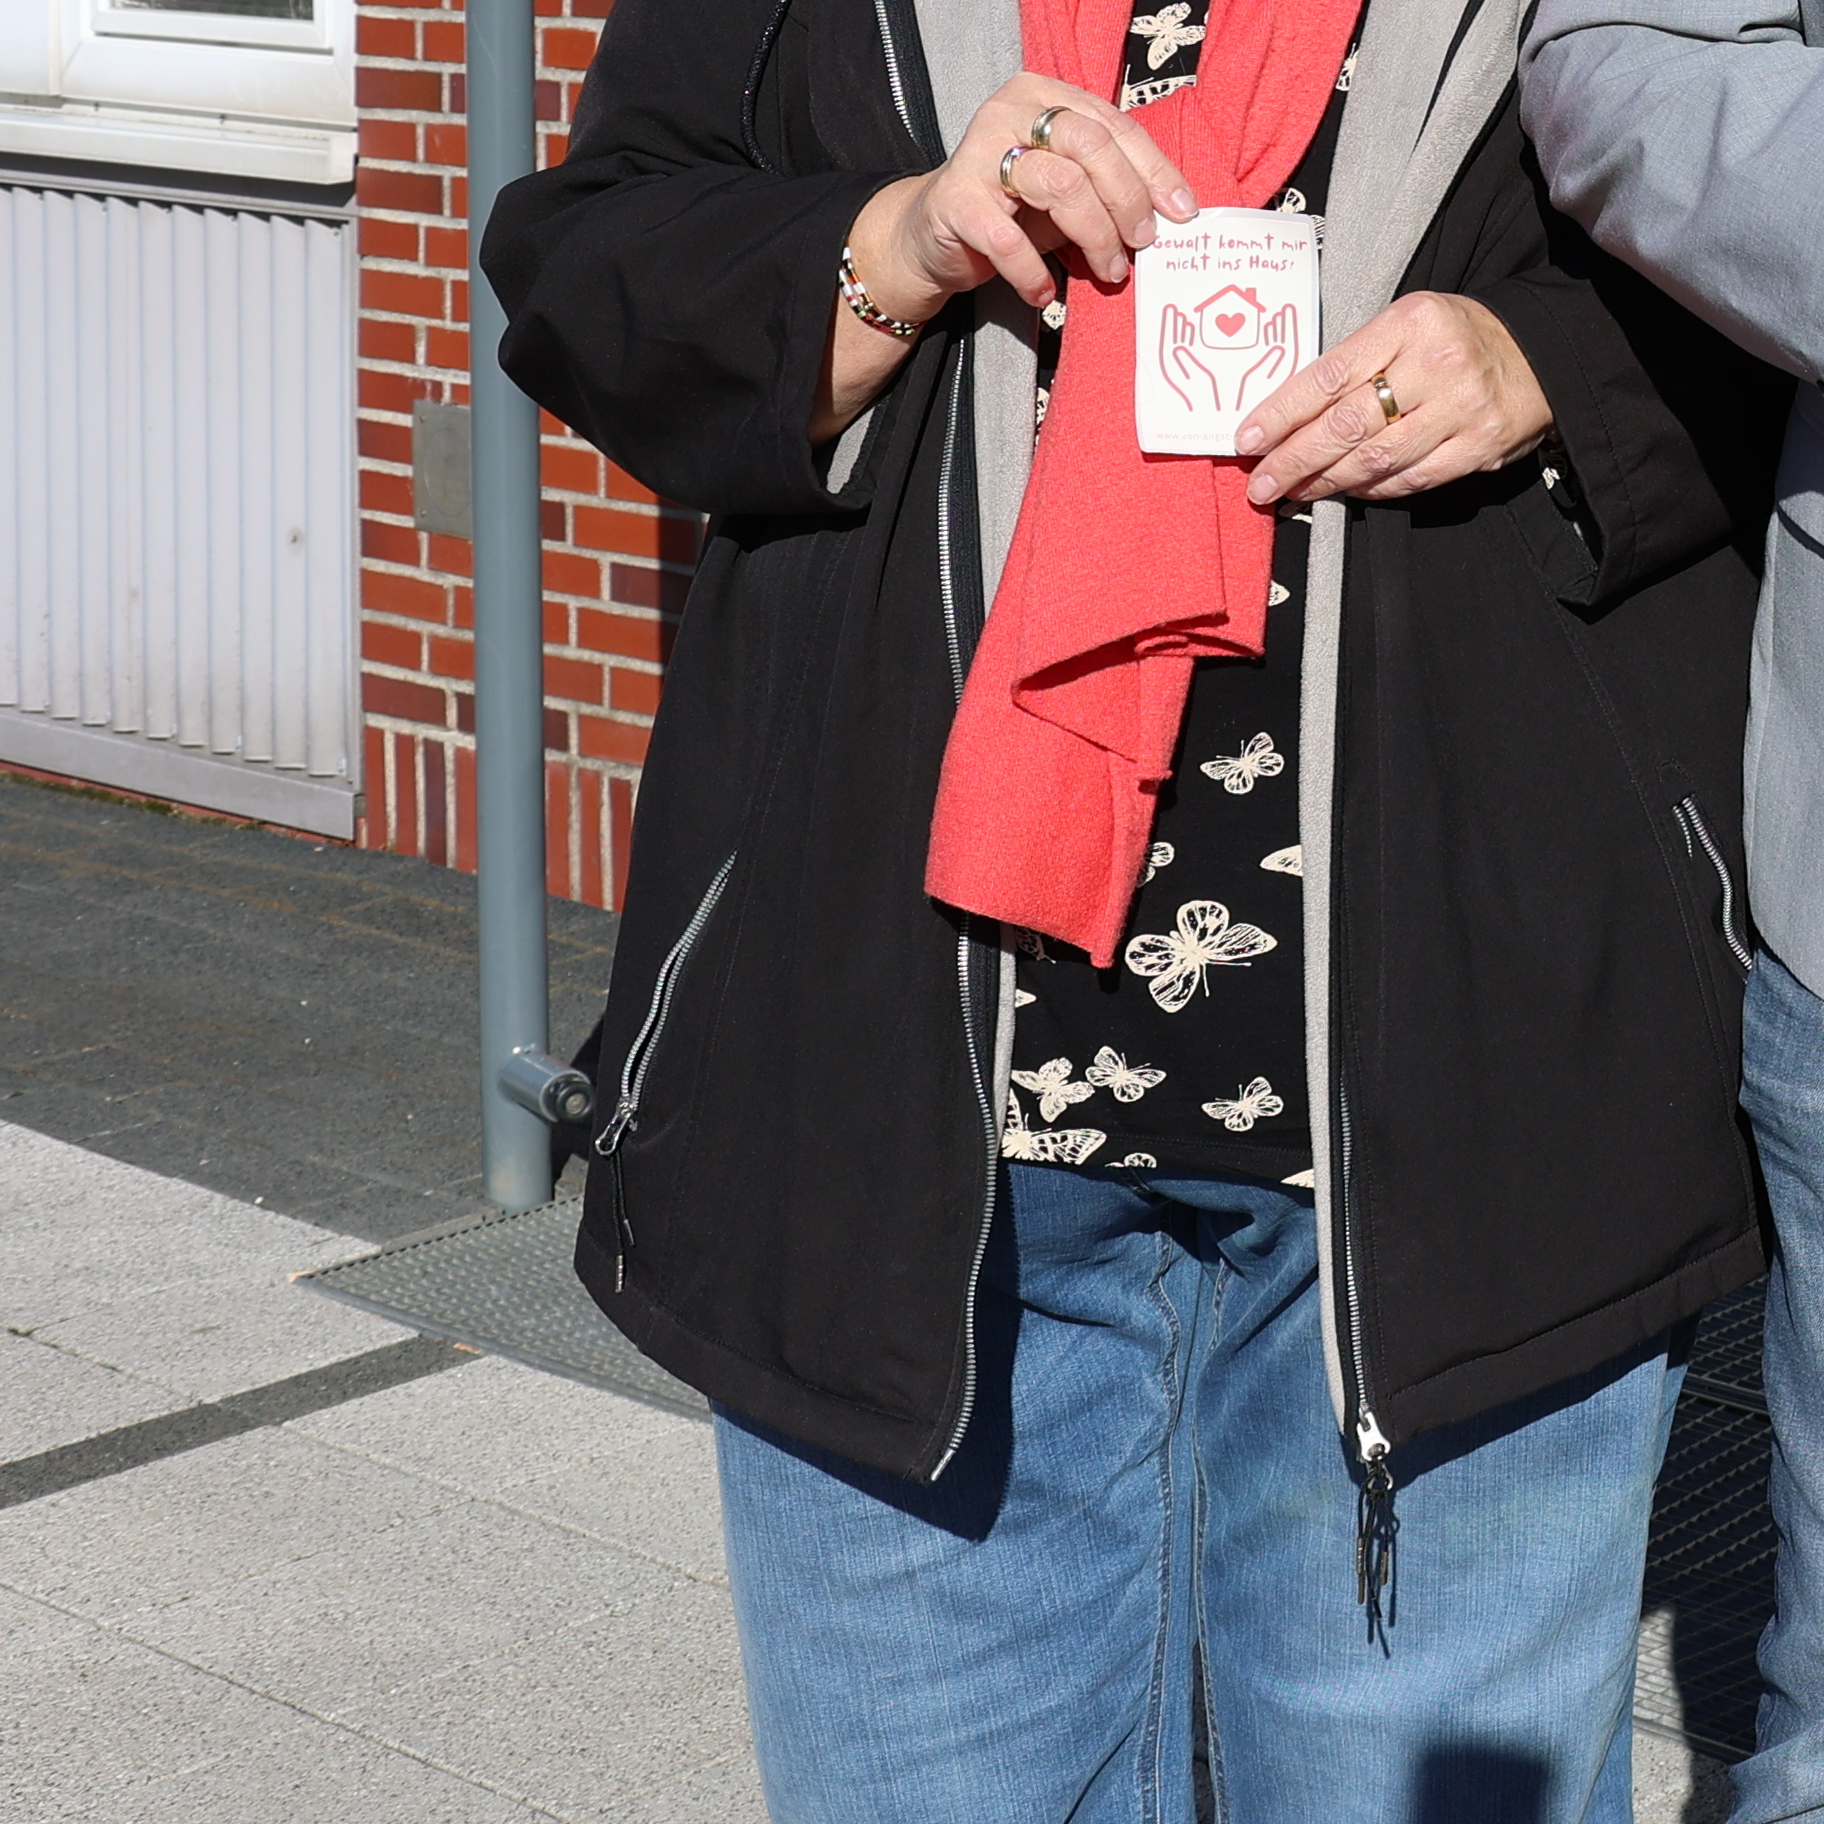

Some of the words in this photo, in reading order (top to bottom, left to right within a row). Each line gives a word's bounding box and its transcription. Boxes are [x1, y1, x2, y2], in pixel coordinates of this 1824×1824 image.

[1152, 232, 1212, 251] Gewalt
[1218, 232, 1275, 251] kommt
[1281, 239, 1308, 251] mir
[1166, 254, 1211, 271] nicht
[1217, 256, 1241, 271] ins
[1249, 254, 1295, 272] Haus!
